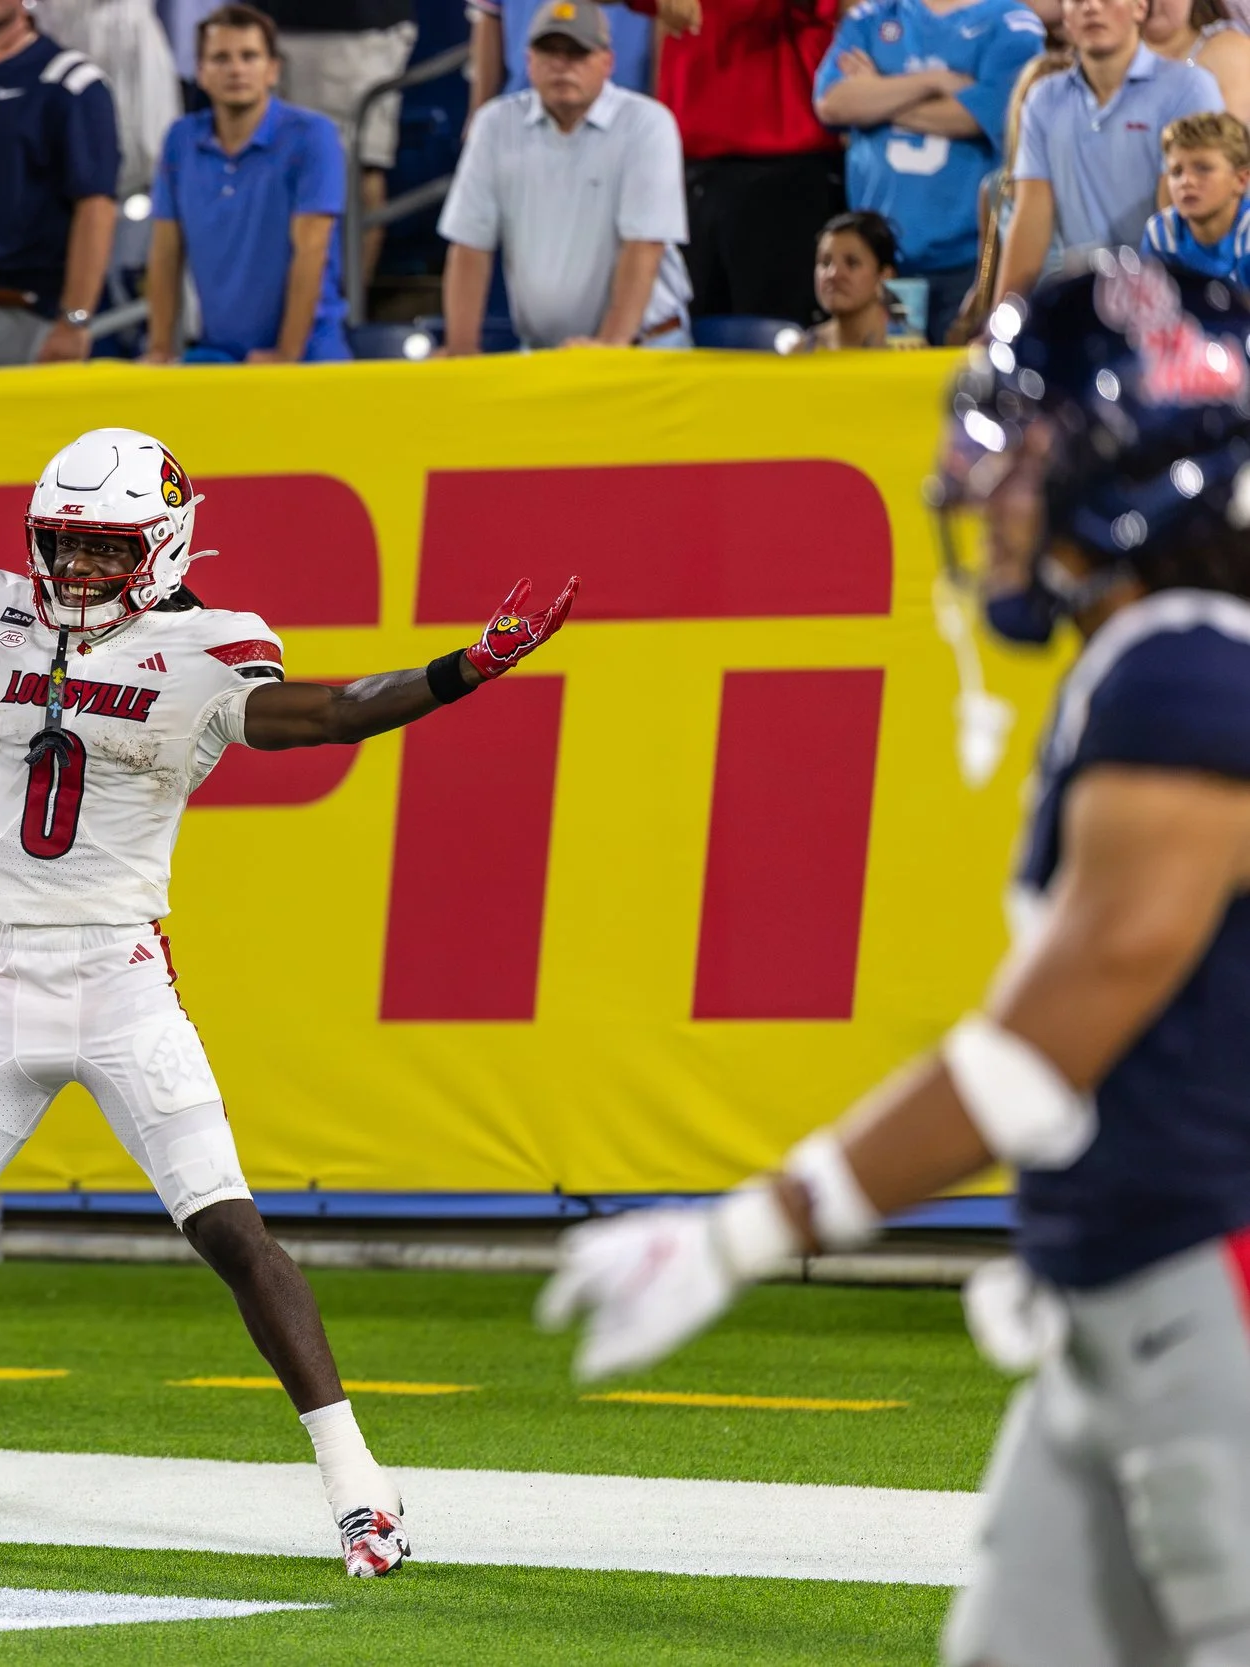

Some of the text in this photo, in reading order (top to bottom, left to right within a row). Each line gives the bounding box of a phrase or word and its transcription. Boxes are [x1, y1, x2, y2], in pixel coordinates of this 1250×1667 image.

[56, 504, 85, 515] ACC
[4, 610, 33, 623] L&N
[1, 633, 24, 643] ACC
[0, 669, 161, 723] LOUSVILLE
[20, 728, 87, 860] 0
